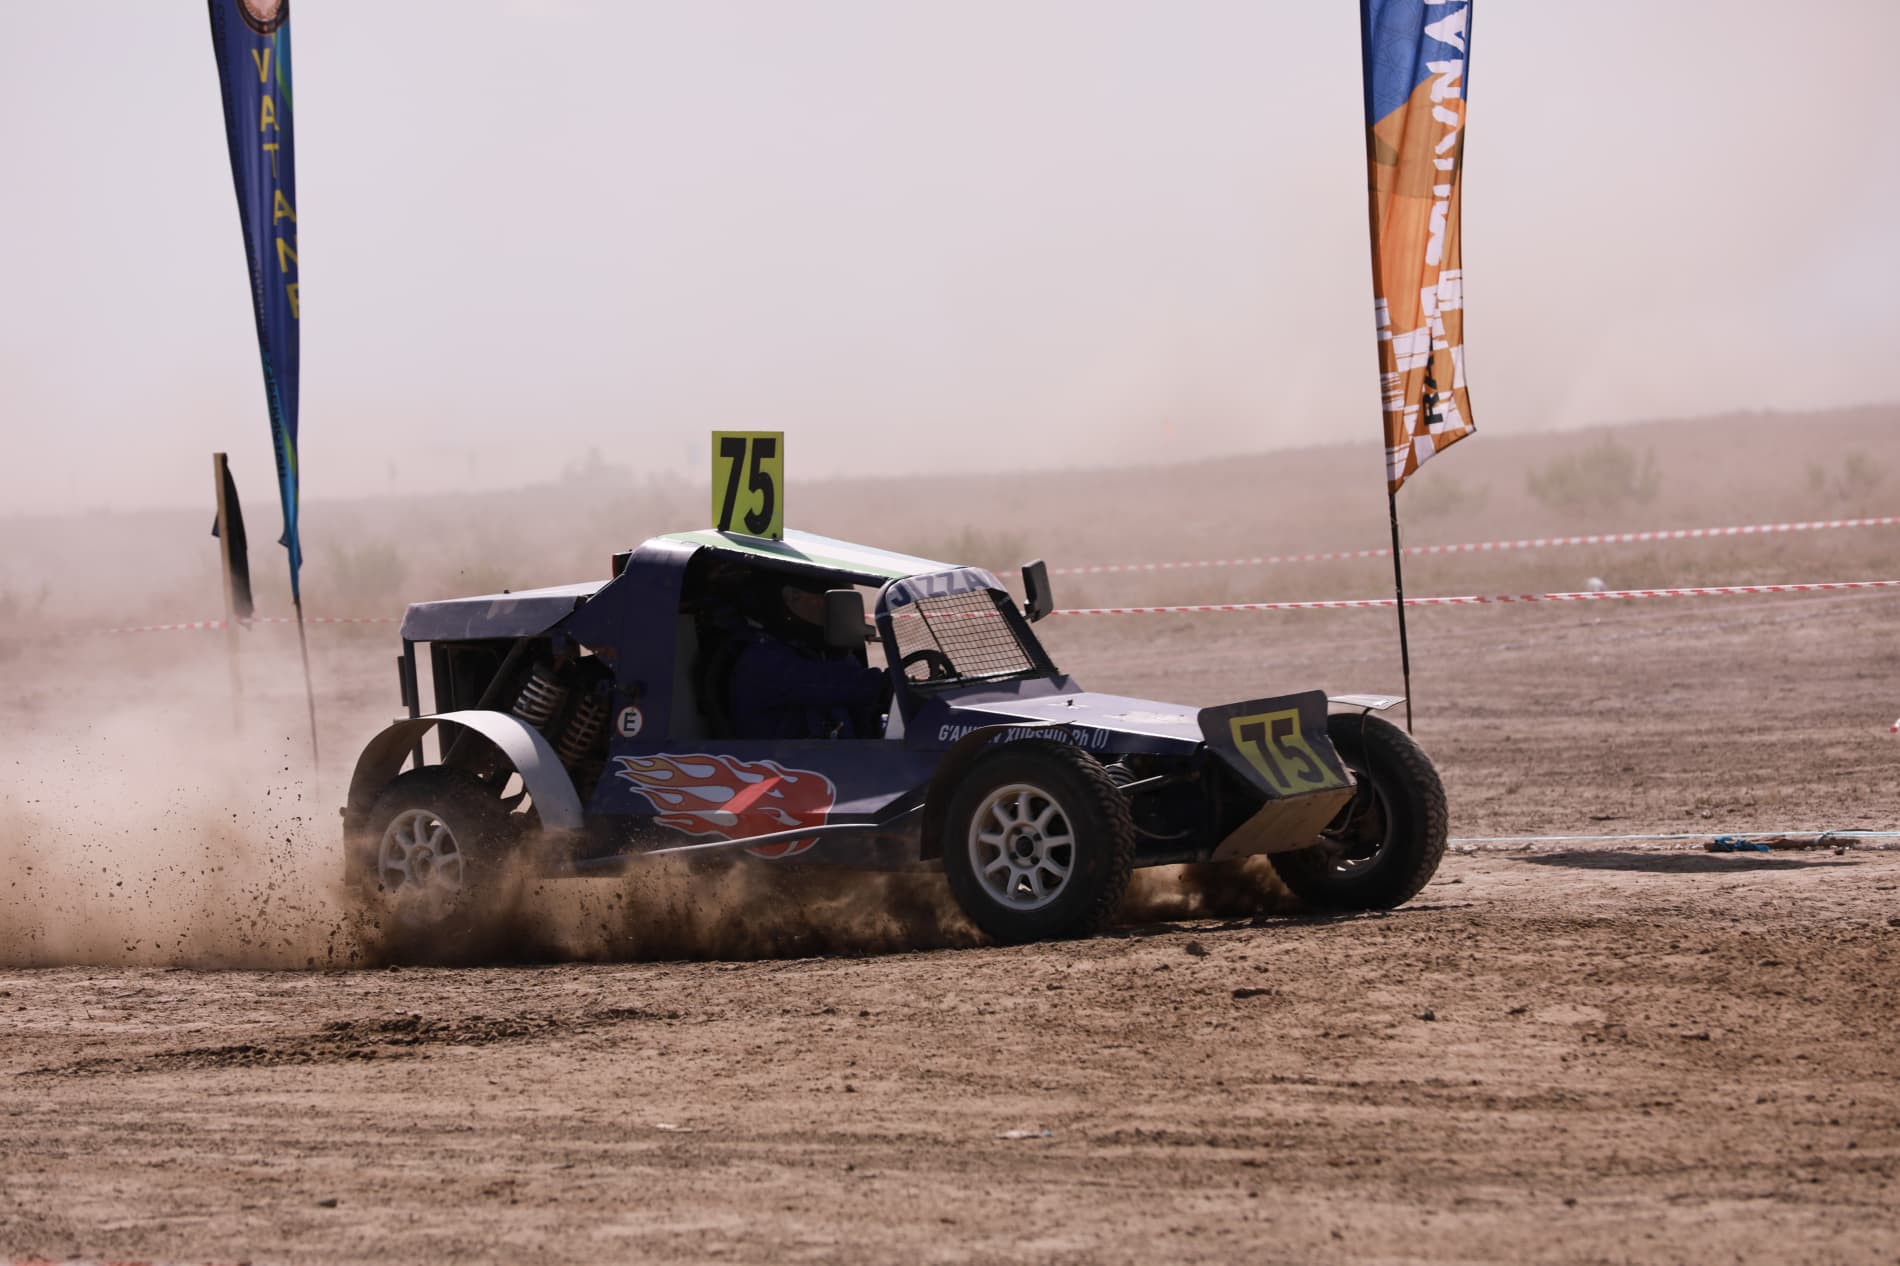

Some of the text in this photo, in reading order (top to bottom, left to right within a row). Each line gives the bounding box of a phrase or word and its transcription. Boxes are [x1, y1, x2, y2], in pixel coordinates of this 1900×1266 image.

[718, 437, 776, 535] 75
[623, 711, 638, 732] E
[1239, 716, 1325, 789] 75
